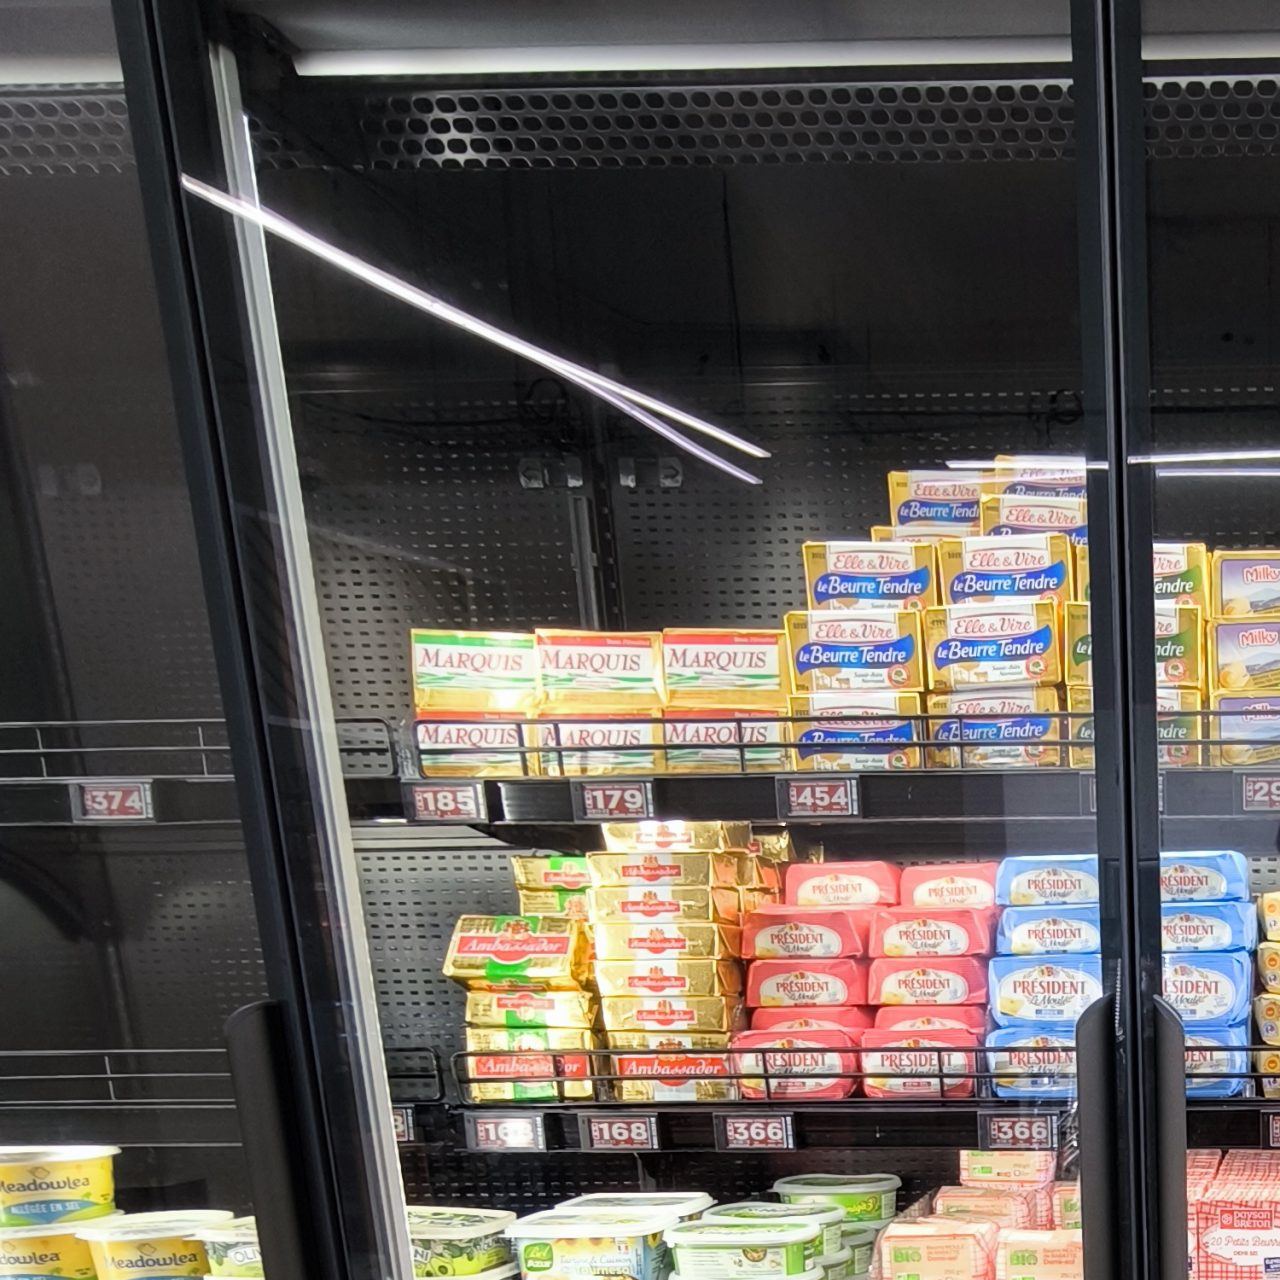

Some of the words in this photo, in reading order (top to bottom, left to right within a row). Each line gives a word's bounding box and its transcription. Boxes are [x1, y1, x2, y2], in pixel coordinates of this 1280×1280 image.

[1006, 508, 1035, 525] Elle
[1046, 511, 1077, 525] Vire
[953, 579, 963, 591] le
[963, 575, 1011, 593] Beurre
[1012, 573, 1058, 590] Tendre
[1244, 566, 1279, 583] Milky
[817, 581, 827, 592] le
[828, 577, 874, 594] Beurre
[877, 577, 921, 594] Tendre
[1239, 629, 1276, 647] Milky
[419, 647, 523, 672] MARQUIS
[540, 649, 641, 672] MARQUIS
[667, 648, 767, 672] MARQUIS
[420, 725, 518, 746] MARQUIS
[93, 791, 141, 810] 374
[424, 792, 473, 810] 185
[593, 790, 642, 809] 179
[798, 786, 848, 806] 454
[1027, 878, 1082, 892] PRÉSIDENT
[771, 932, 823, 944] PRÉSIDENT
[899, 930, 951, 941] PRÉSIDENT
[1028, 927, 1082, 940] PRÉSIDENT
[464, 938, 561, 951] Ambassador
[776, 981, 829, 993] PRÉSIDENT
[898, 979, 951, 990] PRÉSIDENT
[1013, 978, 1086, 995] PRÉSIDENT
[625, 1058, 721, 1074] Ambassador
[599, 1123, 647, 1140] 168
[733, 1122, 782, 1139] 366
[998, 1121, 1047, 1139] 366
[49, 1202, 62, 1213] EN
[65, 1201, 81, 1211] SEL
[1234, 1211, 1269, 1221] paysan
[1234, 1219, 1271, 1228] BRETON
[1211, 1237, 1222, 1247] 20
[1225, 1236, 1249, 1248] Petits
[893, 1250, 921, 1264] BIO
[1010, 1251, 1038, 1266] BIO
